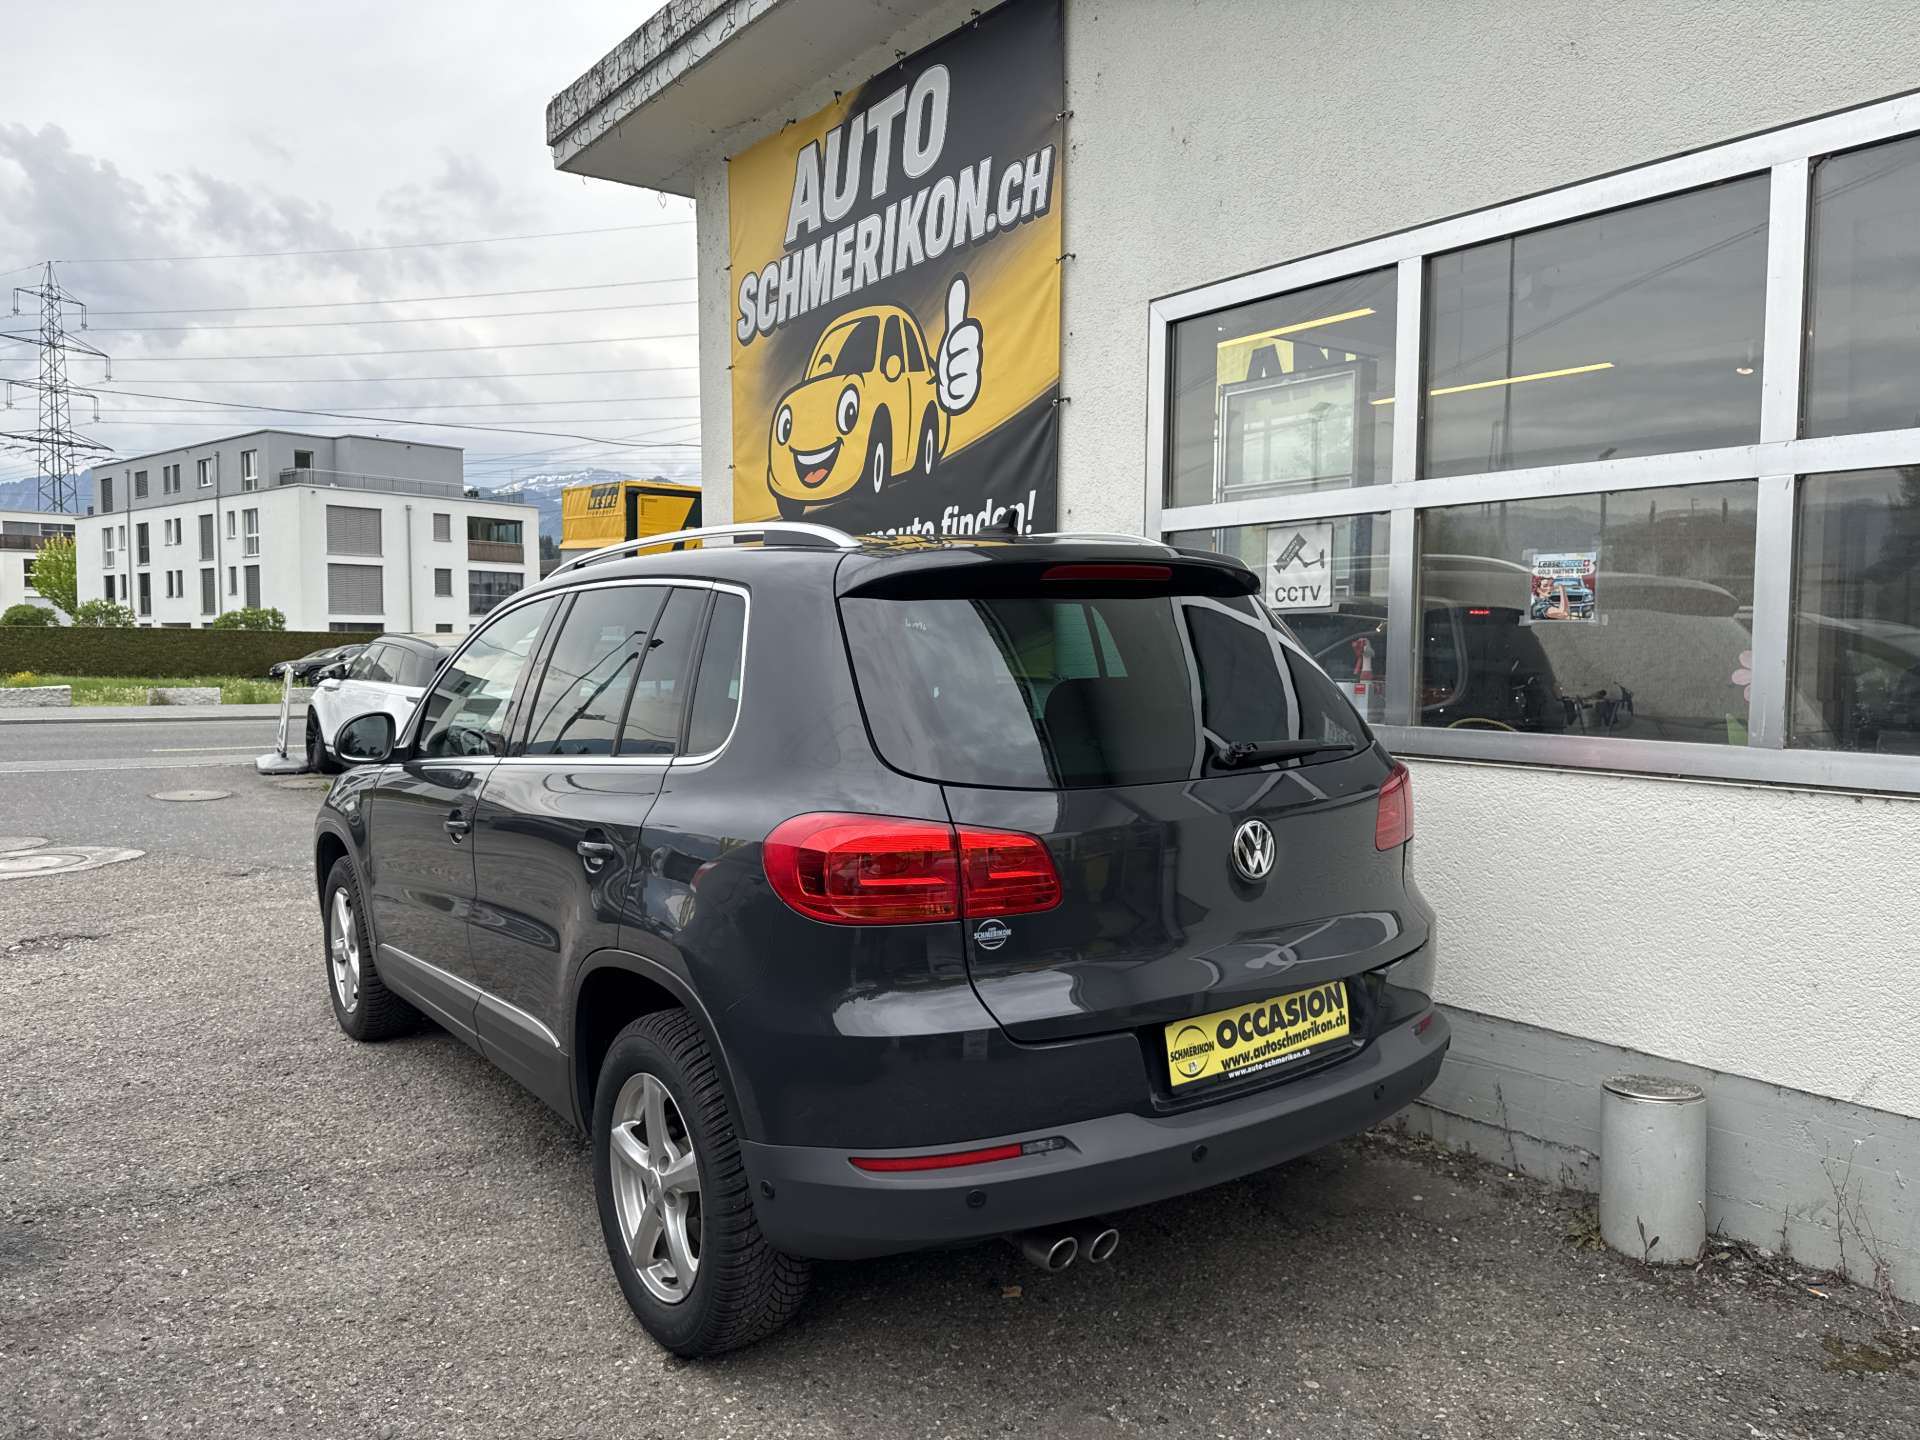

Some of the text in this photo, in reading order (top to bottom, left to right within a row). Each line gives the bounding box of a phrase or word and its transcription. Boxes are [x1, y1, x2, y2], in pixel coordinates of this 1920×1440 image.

[784, 64, 950, 248] AUTO
[737, 146, 1055, 344] SCHMERIKON.CH
[1275, 585, 1321, 602] CCTV
[1216, 983, 1344, 1049] OCCASION
[1221, 1011, 1346, 1070] www.autoschmerikon.ch
[1170, 1041, 1215, 1062] SCHMERIKON
[1228, 1049, 1310, 1079] www.auto-schmerikon.ch
